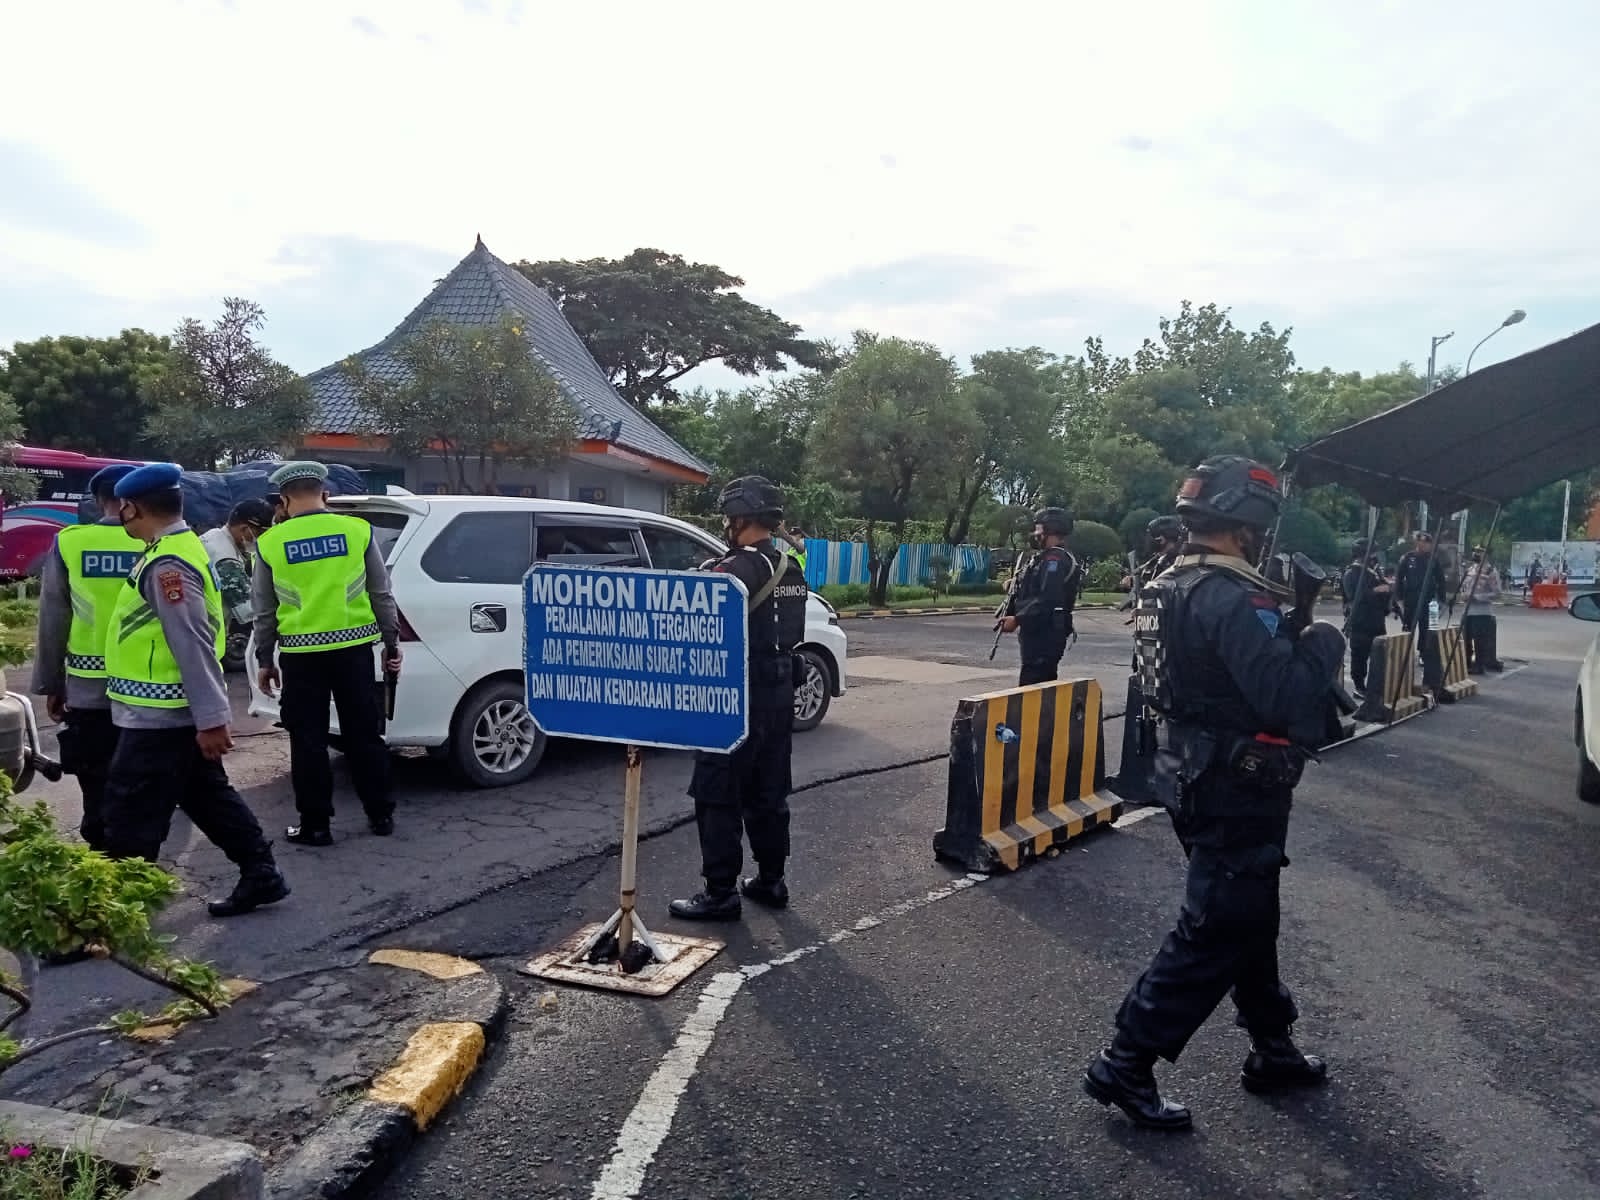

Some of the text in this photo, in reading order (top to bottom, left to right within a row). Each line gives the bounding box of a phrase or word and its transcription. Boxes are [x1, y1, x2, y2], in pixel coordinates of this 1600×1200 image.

[287, 537, 345, 559] POLISI
[532, 573, 729, 615] MOHON MAAF
[773, 585, 806, 598] BRIMOB
[545, 606, 724, 645] PERJALANAN ANDA TERGANGGU
[542, 638, 563, 665] ADA
[566, 640, 643, 672] PEMERIKSAAN
[689, 648, 728, 678] SURAT
[532, 673, 740, 716] DAN MUATAN KENDARAAN BERMOTOR
